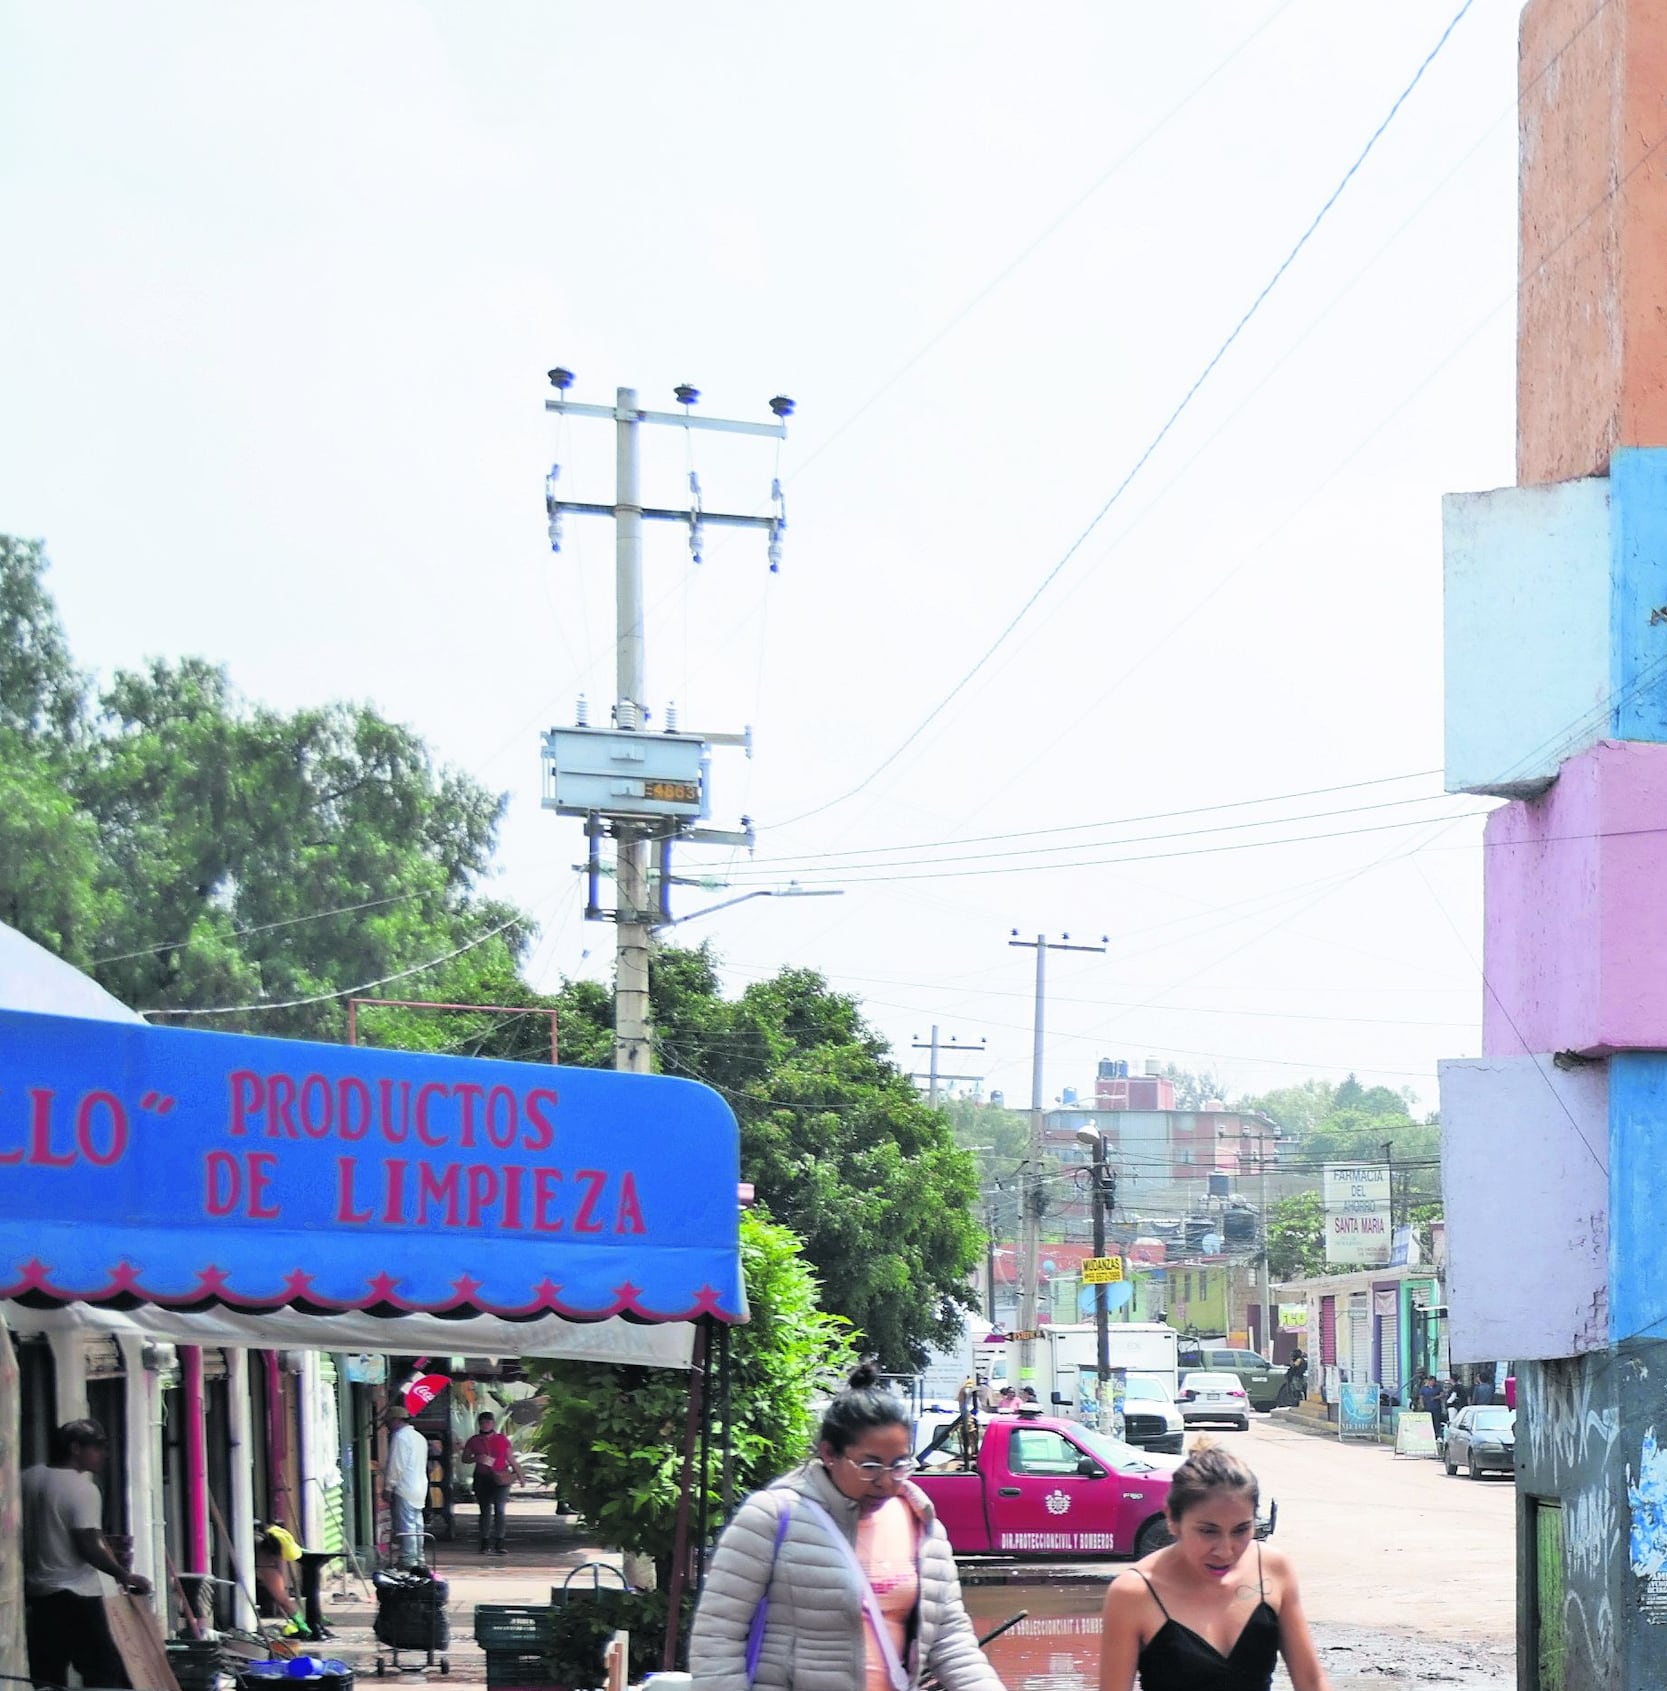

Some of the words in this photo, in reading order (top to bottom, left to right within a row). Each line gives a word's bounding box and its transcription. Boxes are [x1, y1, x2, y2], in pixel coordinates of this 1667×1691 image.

[229, 1069, 560, 1152] PRODUCTOS
[1333, 1168, 1384, 1182] FARMACIA
[205, 1150, 281, 1218] DE
[336, 1155, 647, 1235] LIMPIEZA
[1351, 1185, 1366, 1197] DEL
[1334, 1217, 1358, 1233] SANTA
[1361, 1217, 1385, 1234] MARIA
[1082, 1258, 1120, 1271] MUDANZAS
[1073, 1534, 1079, 1549] Y
[1079, 1533, 1114, 1549] BOMBEROS
